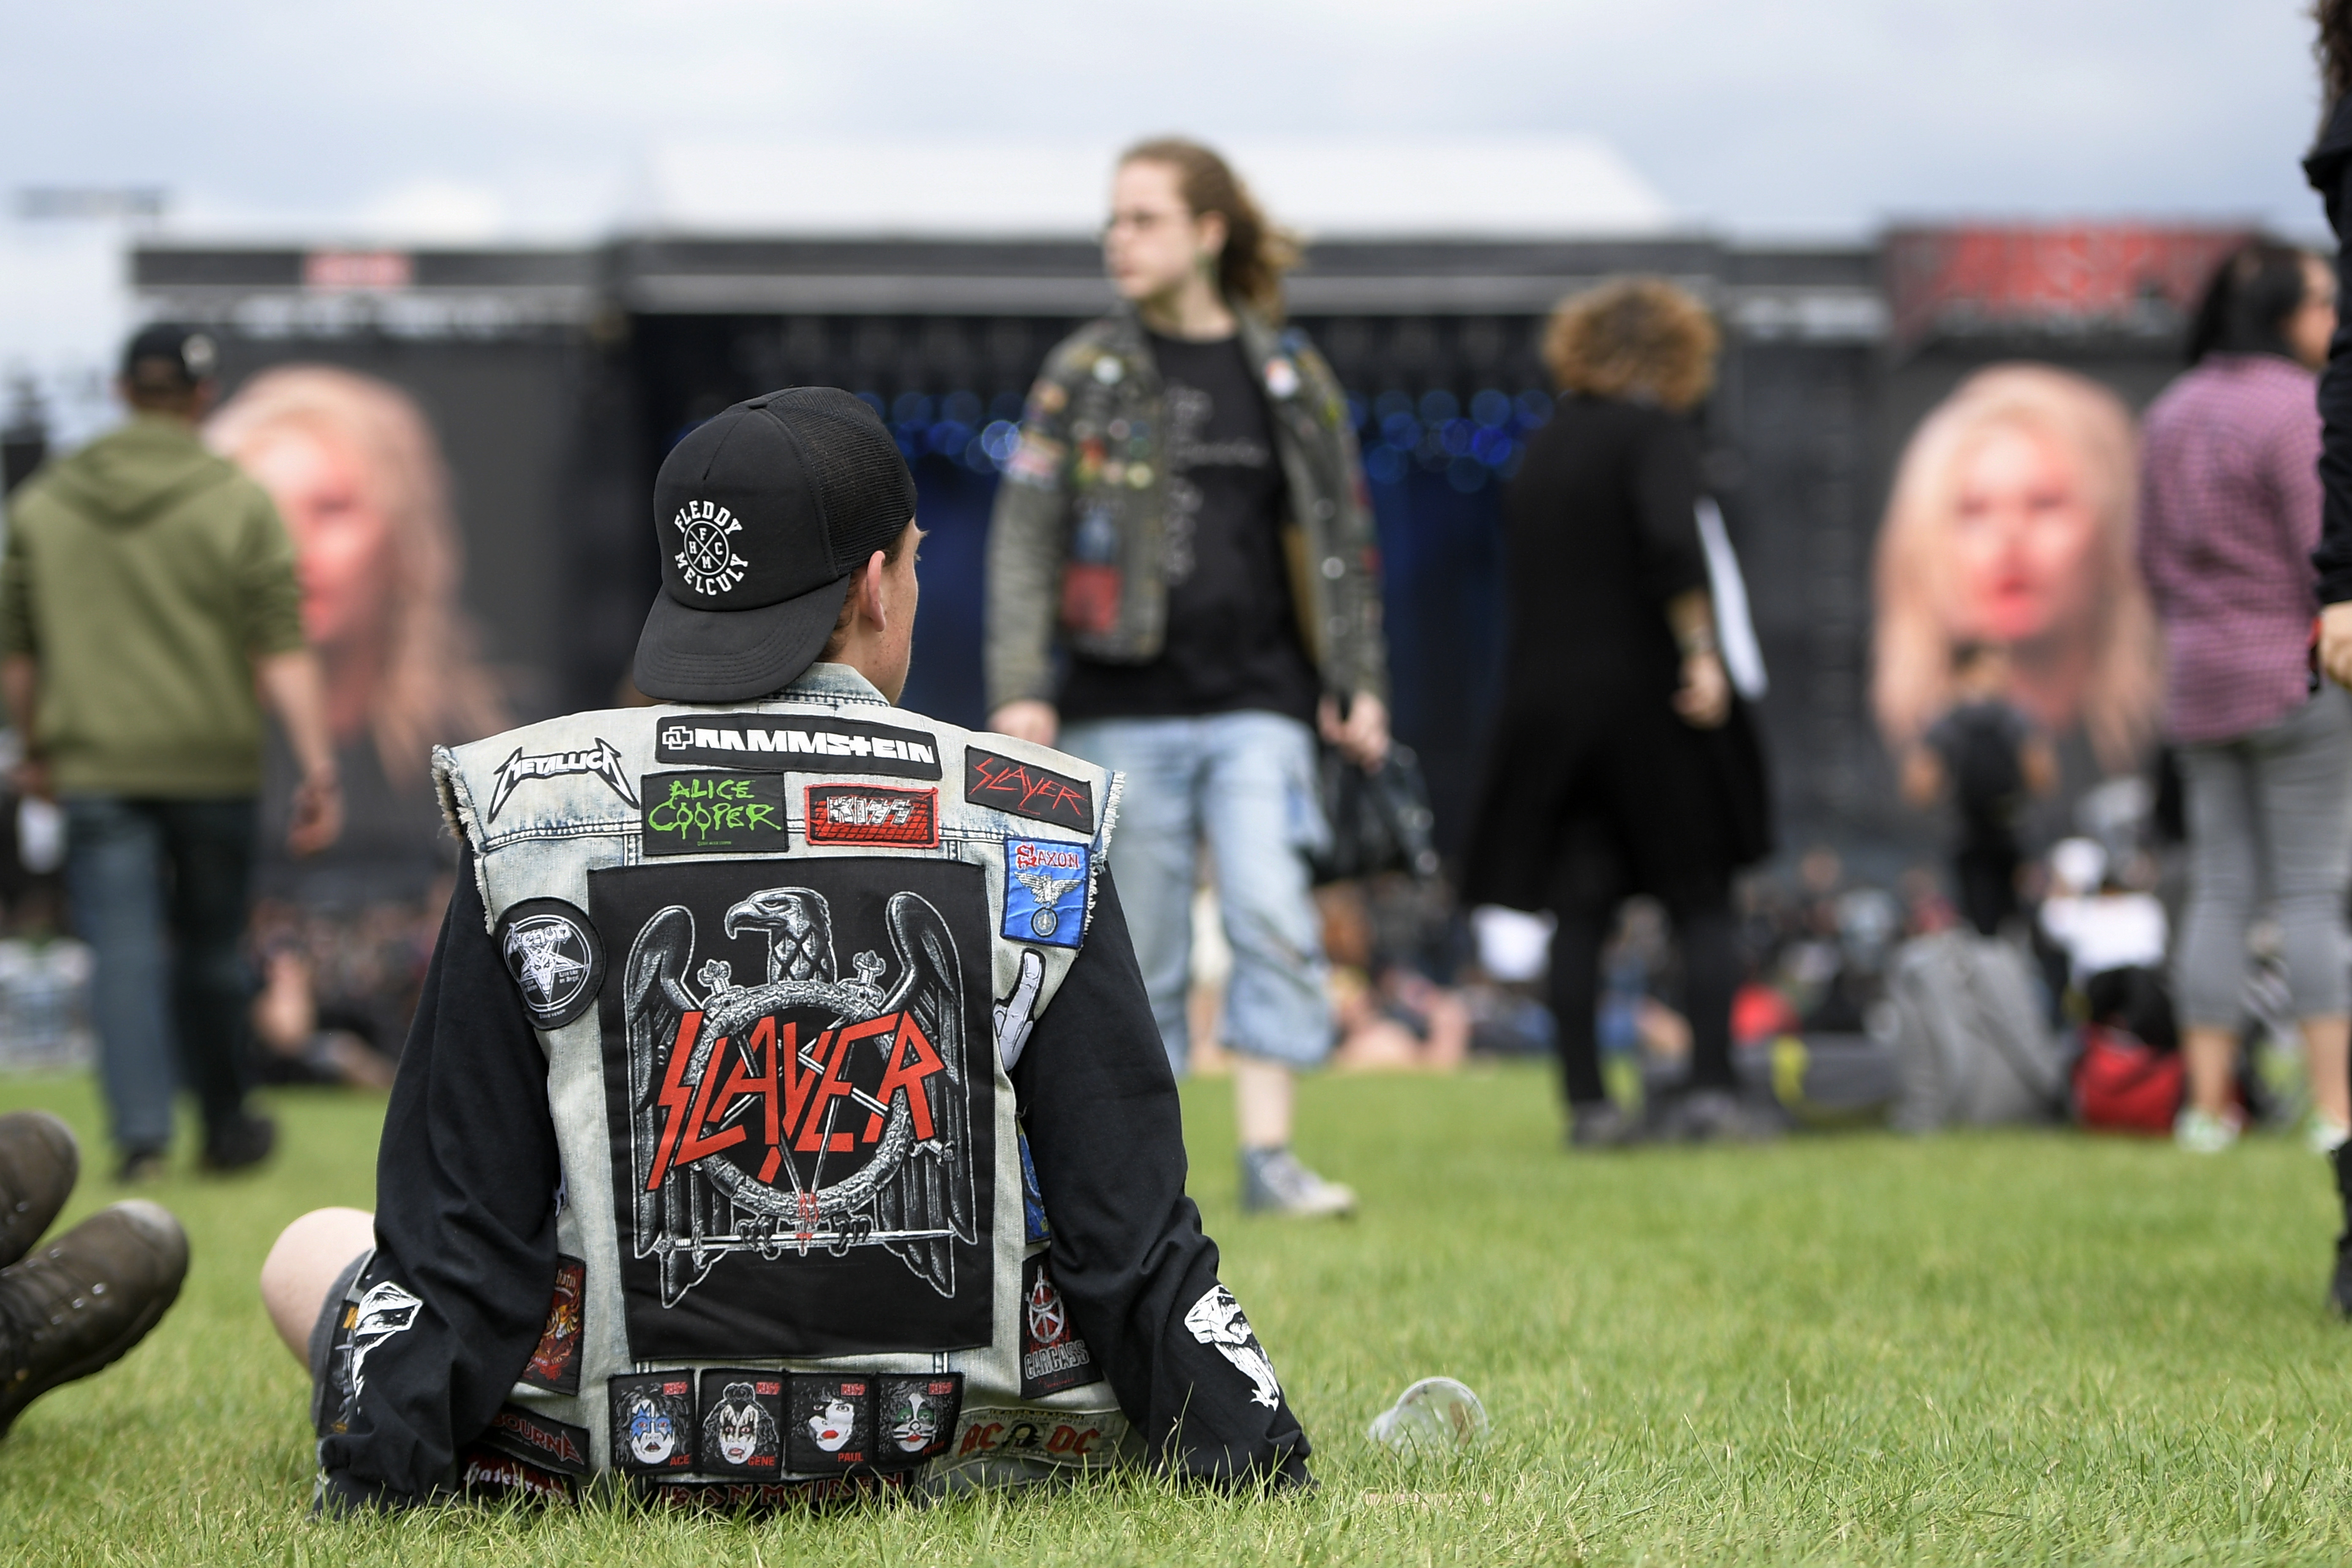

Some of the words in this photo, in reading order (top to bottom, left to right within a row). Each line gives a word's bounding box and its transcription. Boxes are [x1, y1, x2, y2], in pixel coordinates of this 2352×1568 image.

[675, 500, 743, 534] FLEDDY
[699, 528, 707, 541] F
[715, 542, 723, 555] C
[675, 552, 749, 596] MELCULY
[702, 555, 712, 569] M
[695, 728, 934, 764] RAMMSTEIN
[489, 738, 639, 822] METALLICA
[670, 779, 754, 802] ALICE
[969, 757, 1089, 816] SLAYER
[648, 801, 781, 839] COOPER
[826, 795, 915, 825] KISS
[1015, 843, 1080, 870] SAXON
[646, 1010, 945, 1190] SLAYER
[1024, 1339, 1090, 1380] CARCASS
[841, 1383, 867, 1396] KISS
[493, 1414, 584, 1465] BOURNE
[670, 1454, 690, 1466] ACE
[748, 1456, 775, 1467] GENE
[838, 1452, 863, 1462] PAUL
